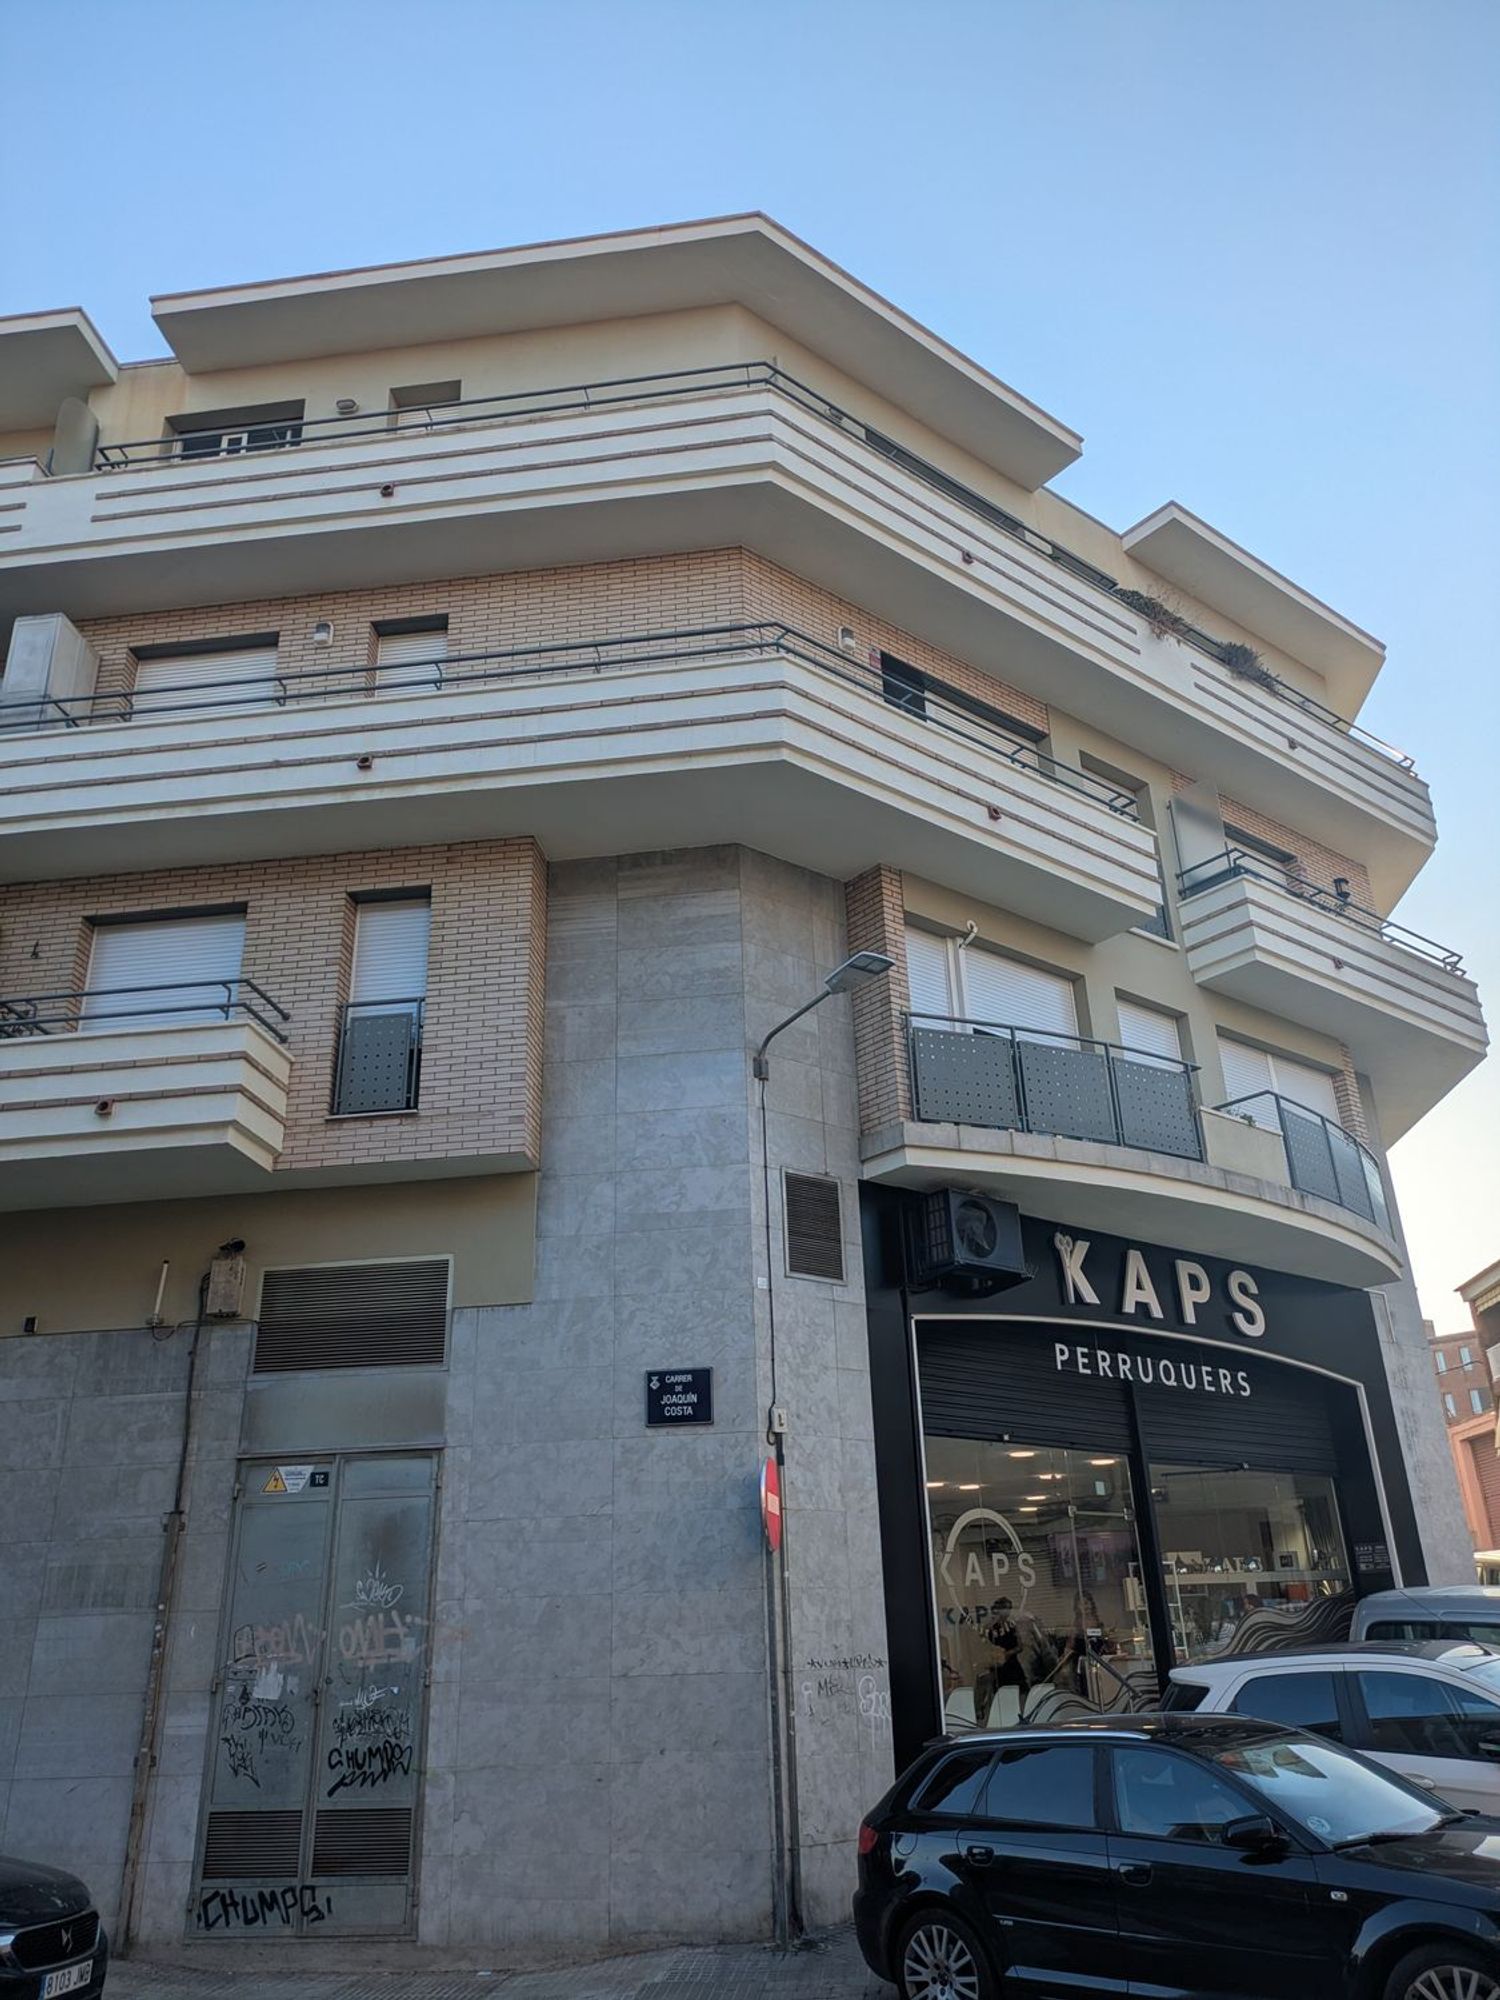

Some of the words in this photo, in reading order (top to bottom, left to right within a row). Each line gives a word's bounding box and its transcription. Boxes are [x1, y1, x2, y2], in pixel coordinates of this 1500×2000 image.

[1054, 1232, 1266, 1337] KAPS
[665, 1374, 693, 1383] CARRER
[1054, 1342, 1251, 1397] PERRUQUERS
[660, 1392, 698, 1405] JOAQUÍN
[664, 1406, 693, 1416] COSTA
[46, 1970, 72, 1996] 8103
